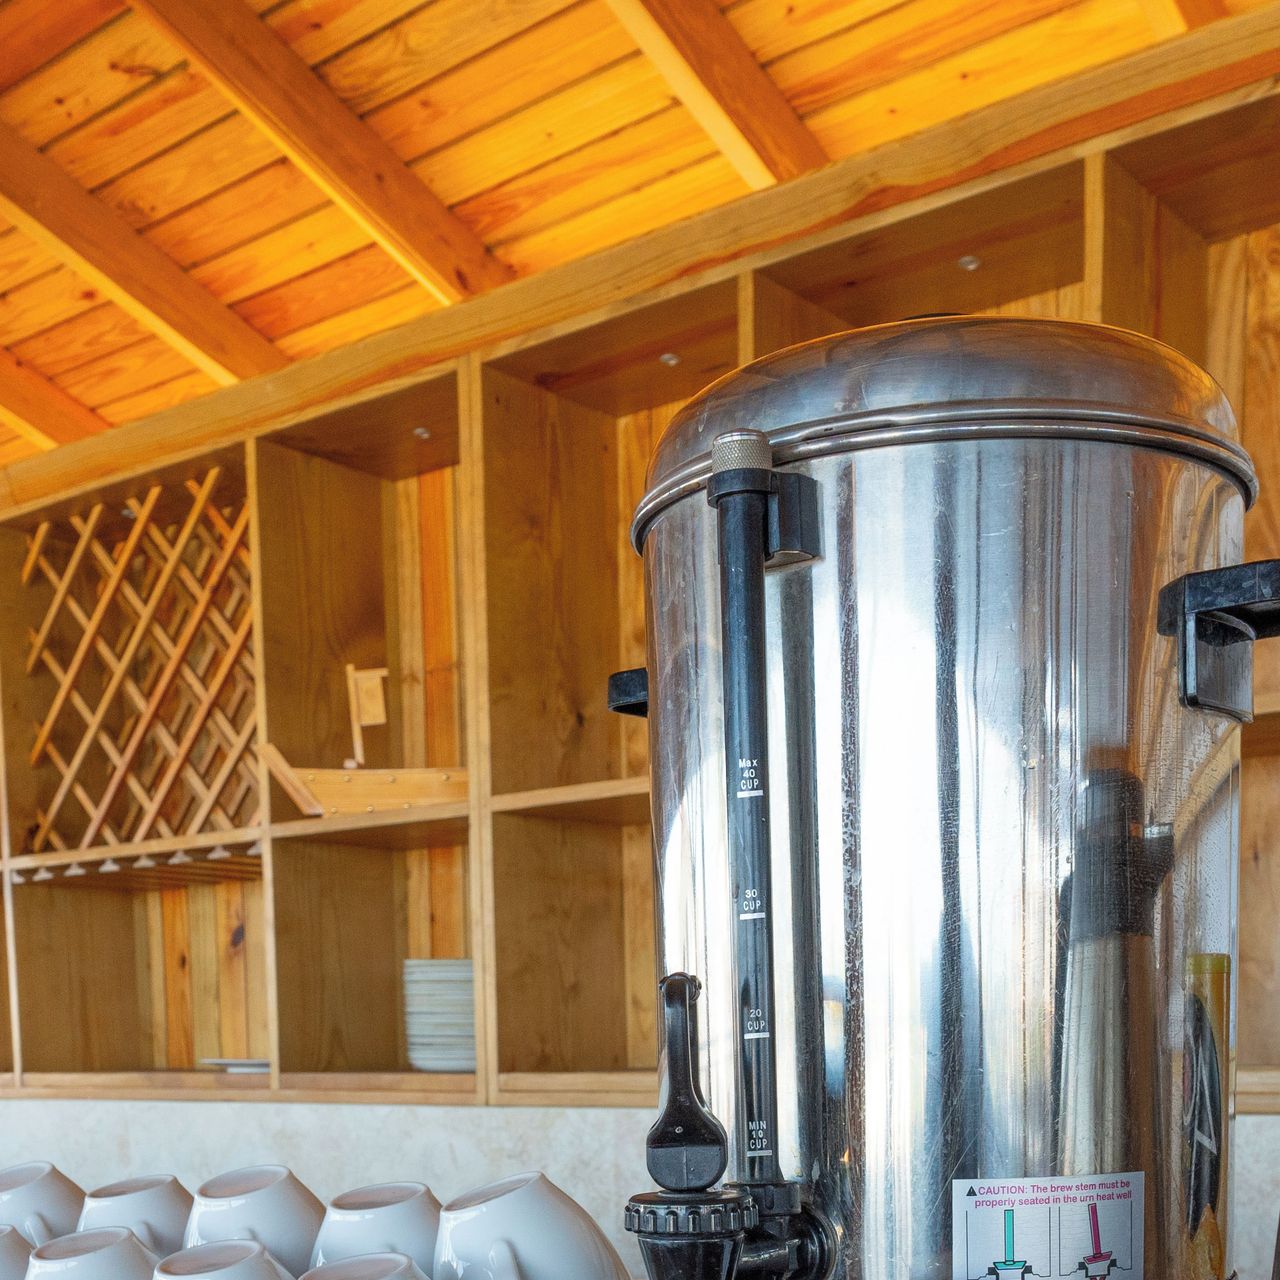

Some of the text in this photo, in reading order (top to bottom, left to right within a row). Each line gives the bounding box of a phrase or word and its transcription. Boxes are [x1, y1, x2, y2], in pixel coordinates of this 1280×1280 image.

[738, 758, 758, 768] Max
[742, 769, 756, 778] 40
[740, 779, 759, 791] CUP
[745, 889, 758, 898] 30
[743, 900, 761, 911] CUP
[749, 1009, 762, 1018] 20
[747, 1021, 766, 1031] CUP
[749, 1121, 767, 1130] MIN
[751, 1130, 764, 1138] 10
[750, 1139, 768, 1149] CUP
[978, 1180, 1131, 1195] CAUTION: The brew stem must be
[974, 1190, 1132, 1208] properly seated in the urn heat well
